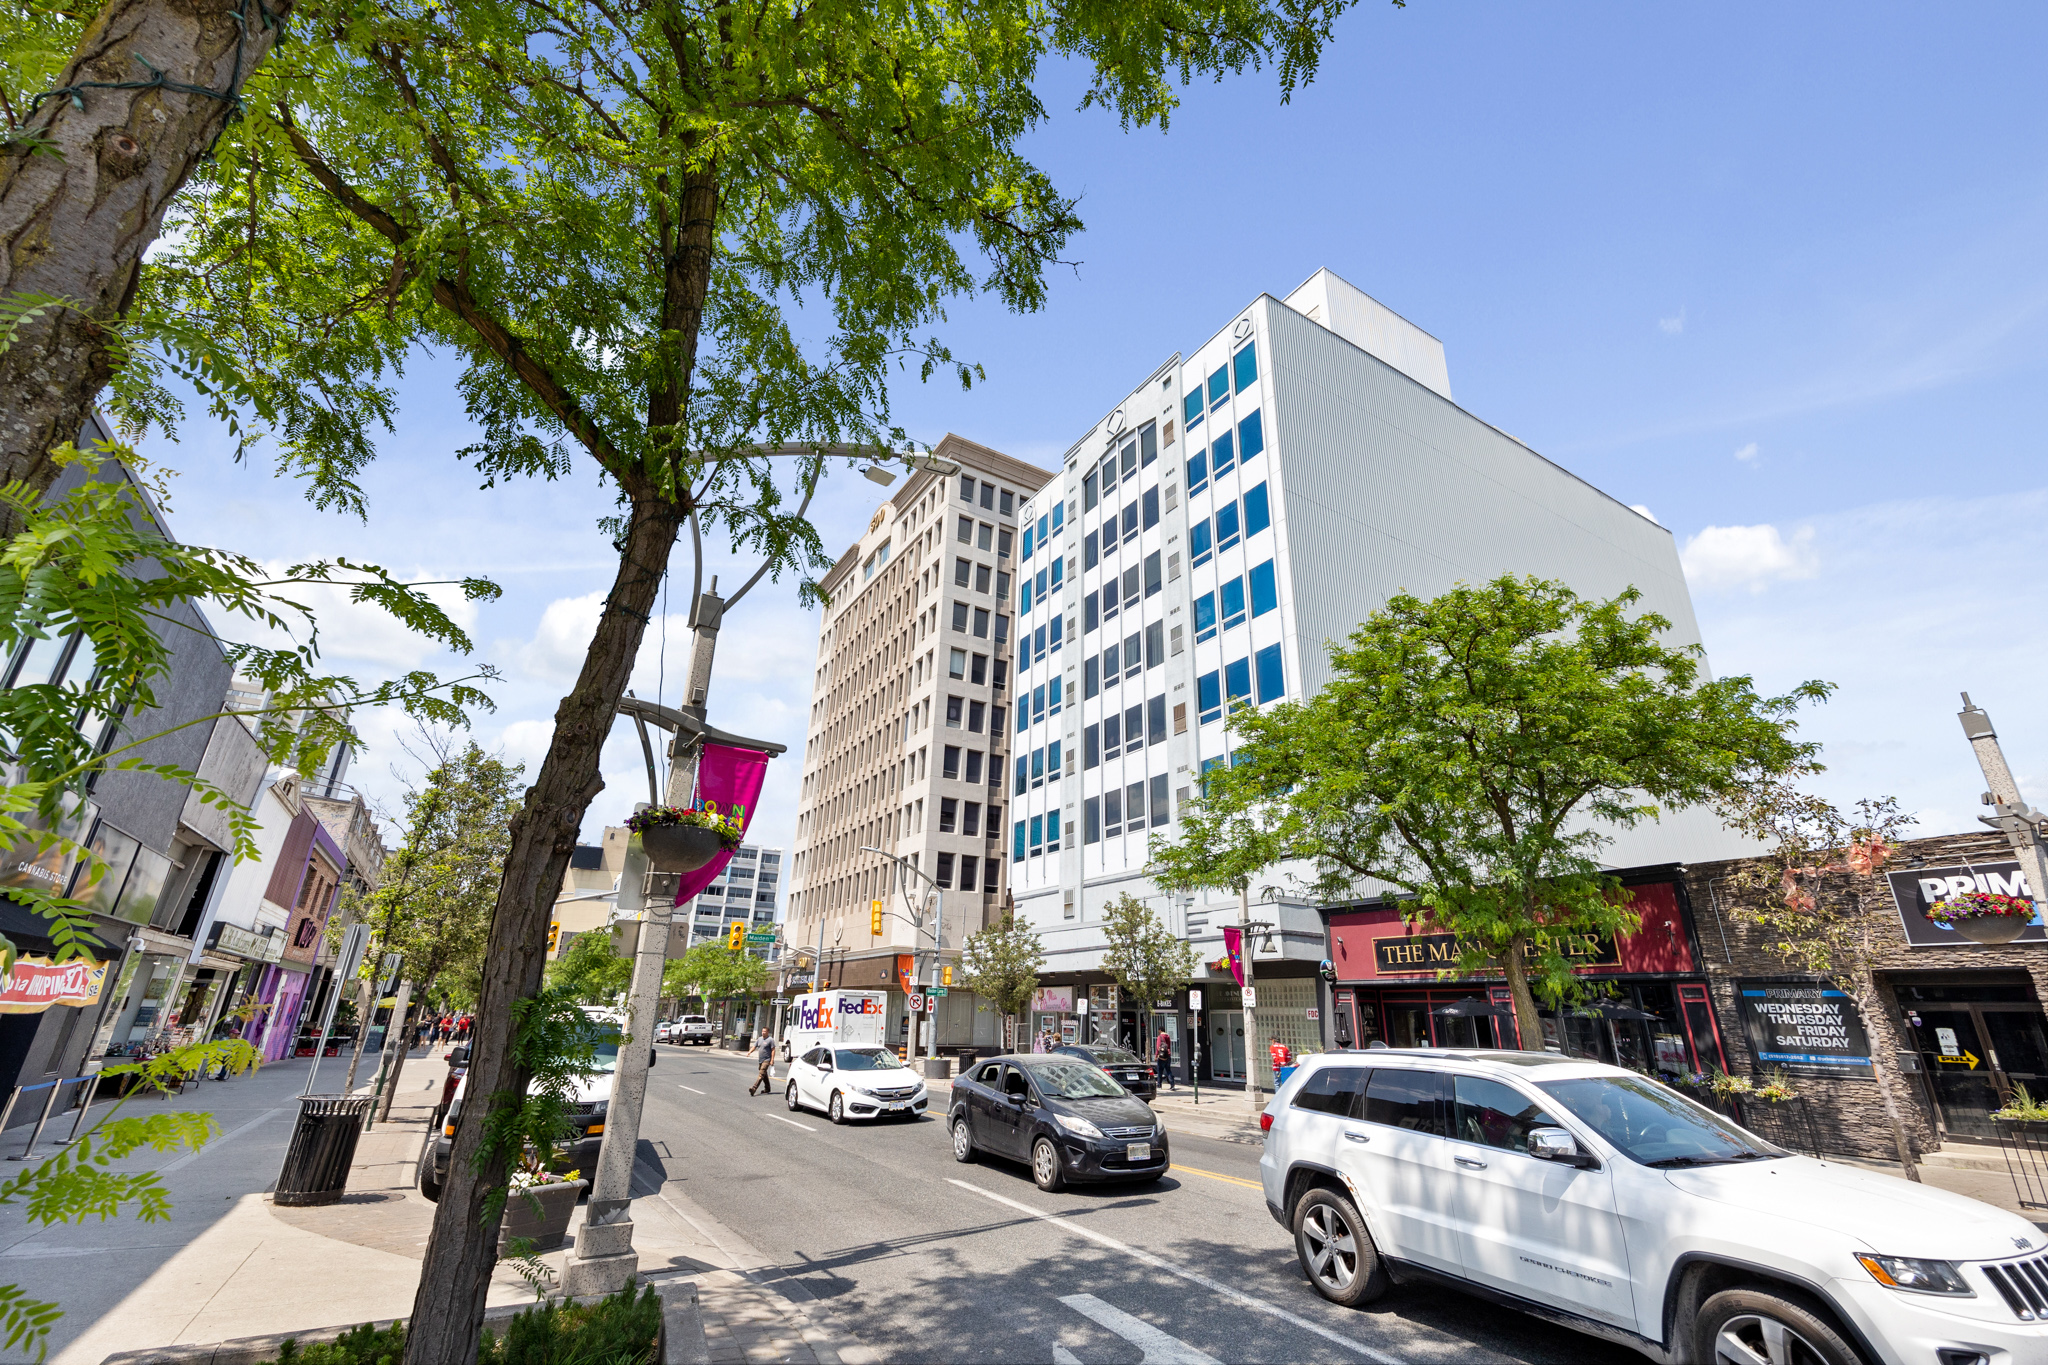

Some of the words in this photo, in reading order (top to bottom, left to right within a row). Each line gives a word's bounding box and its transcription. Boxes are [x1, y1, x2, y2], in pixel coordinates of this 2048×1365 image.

[18, 861, 49, 880] CANNABIS
[49, 871, 68, 886] STORE
[1917, 870, 2034, 904] PRIM
[1382, 944, 1425, 964] THE
[1765, 988, 1823, 999] PRIMARY
[800, 997, 834, 1030] FedEx
[838, 998, 883, 1014] FedEx
[1754, 1003, 1840, 1015] WEDNESDAY
[1768, 1013, 1843, 1026] THURSDAY
[1796, 1025, 1847, 1037] FRIDAY
[1775, 1035, 1850, 1049] SATURDAY
[2010, 1236, 2034, 1250] Jeep
[1519, 1256, 1553, 1270] GRAND
[1554, 1266, 1613, 1288] CHEROKEE
